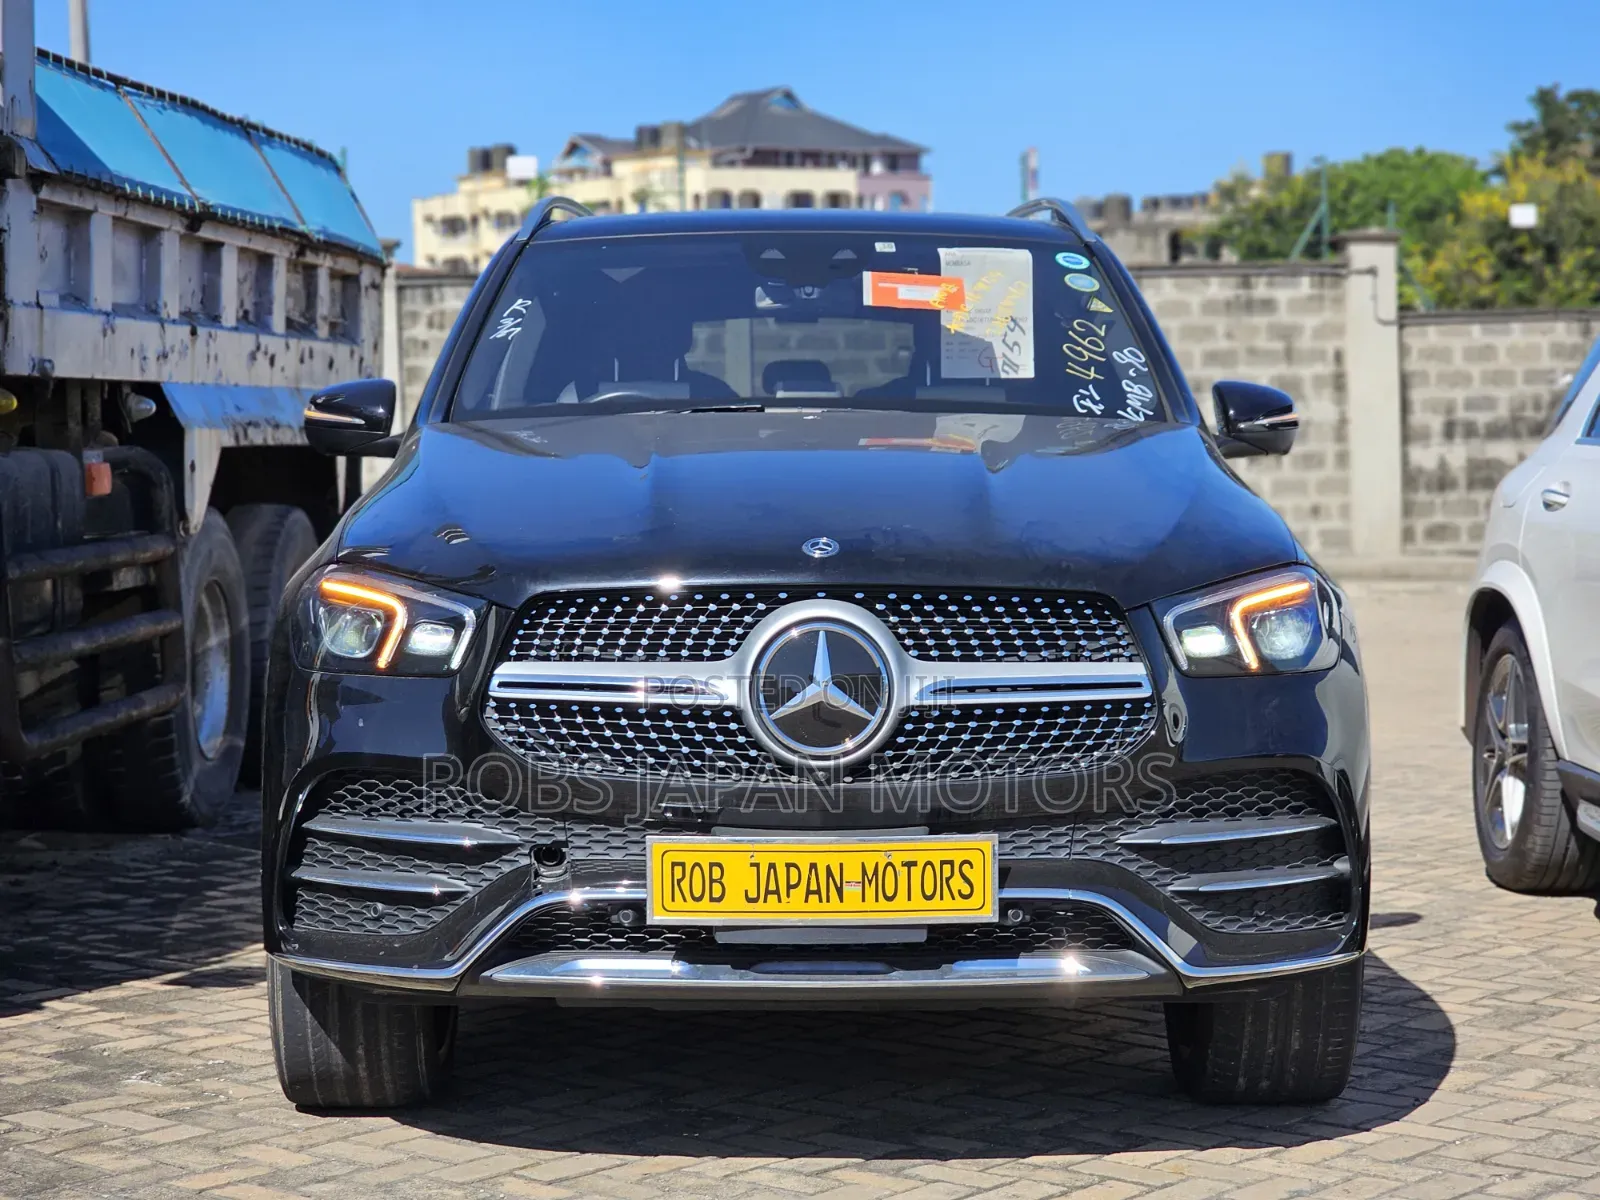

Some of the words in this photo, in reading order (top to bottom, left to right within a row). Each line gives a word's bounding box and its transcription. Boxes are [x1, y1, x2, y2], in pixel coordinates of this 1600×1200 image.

[1062, 319, 1107, 380] 4962
[670, 861, 726, 903] ROB
[744, 861, 844, 904] JAPAN
[861, 859, 975, 903] MOTORS
